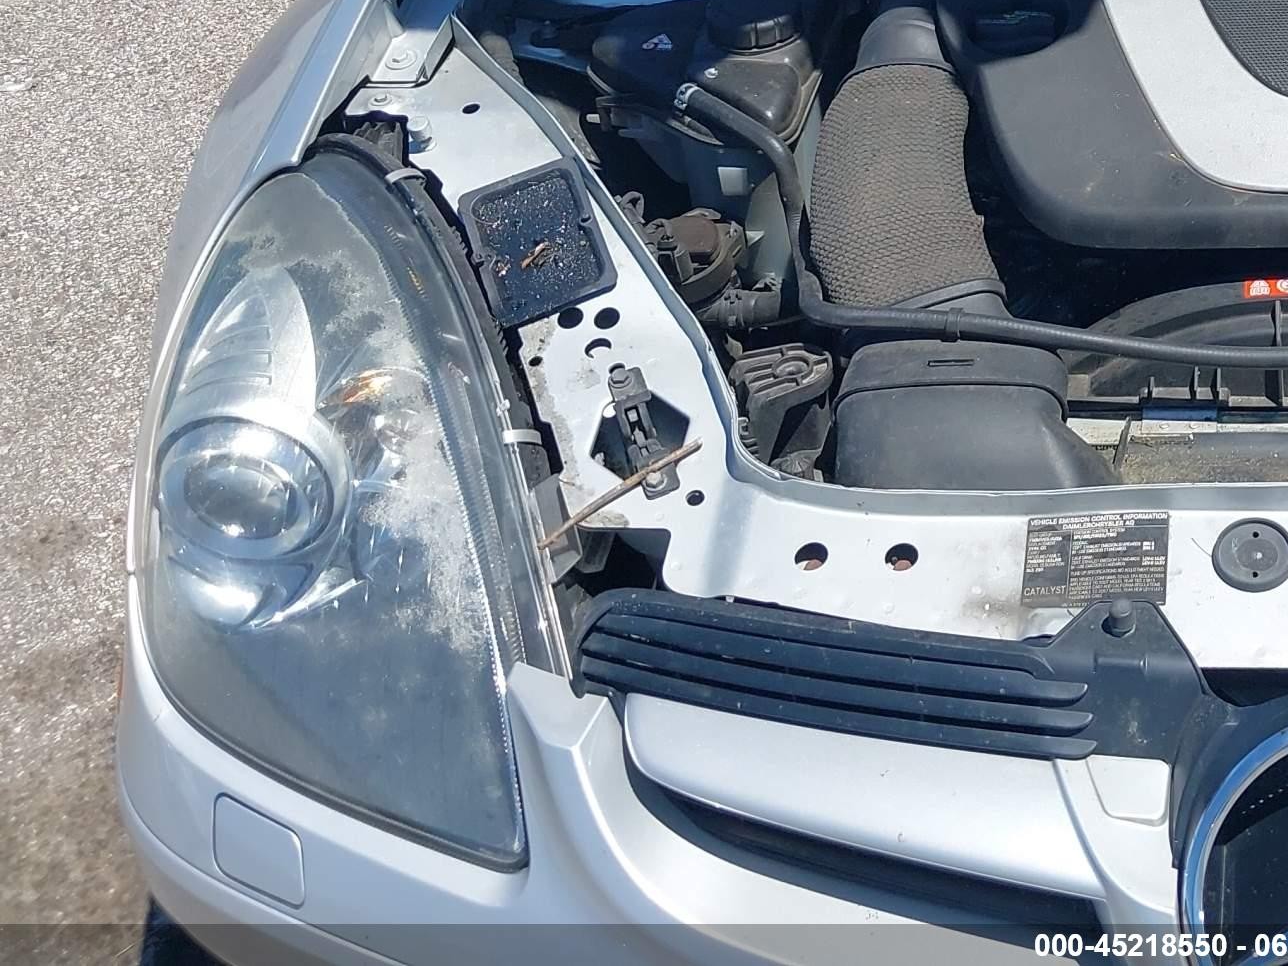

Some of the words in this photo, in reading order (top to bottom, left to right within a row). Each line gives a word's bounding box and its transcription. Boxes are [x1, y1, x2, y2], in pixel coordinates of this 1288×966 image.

[1030, 518, 1057, 526] VEHICLE
[1059, 516, 1090, 525] EMISSION
[1092, 514, 1121, 522] CONTROL
[1063, 521, 1124, 530] DAIMLERCHRYSLER
[1024, 585, 1066, 596] CATALYST
